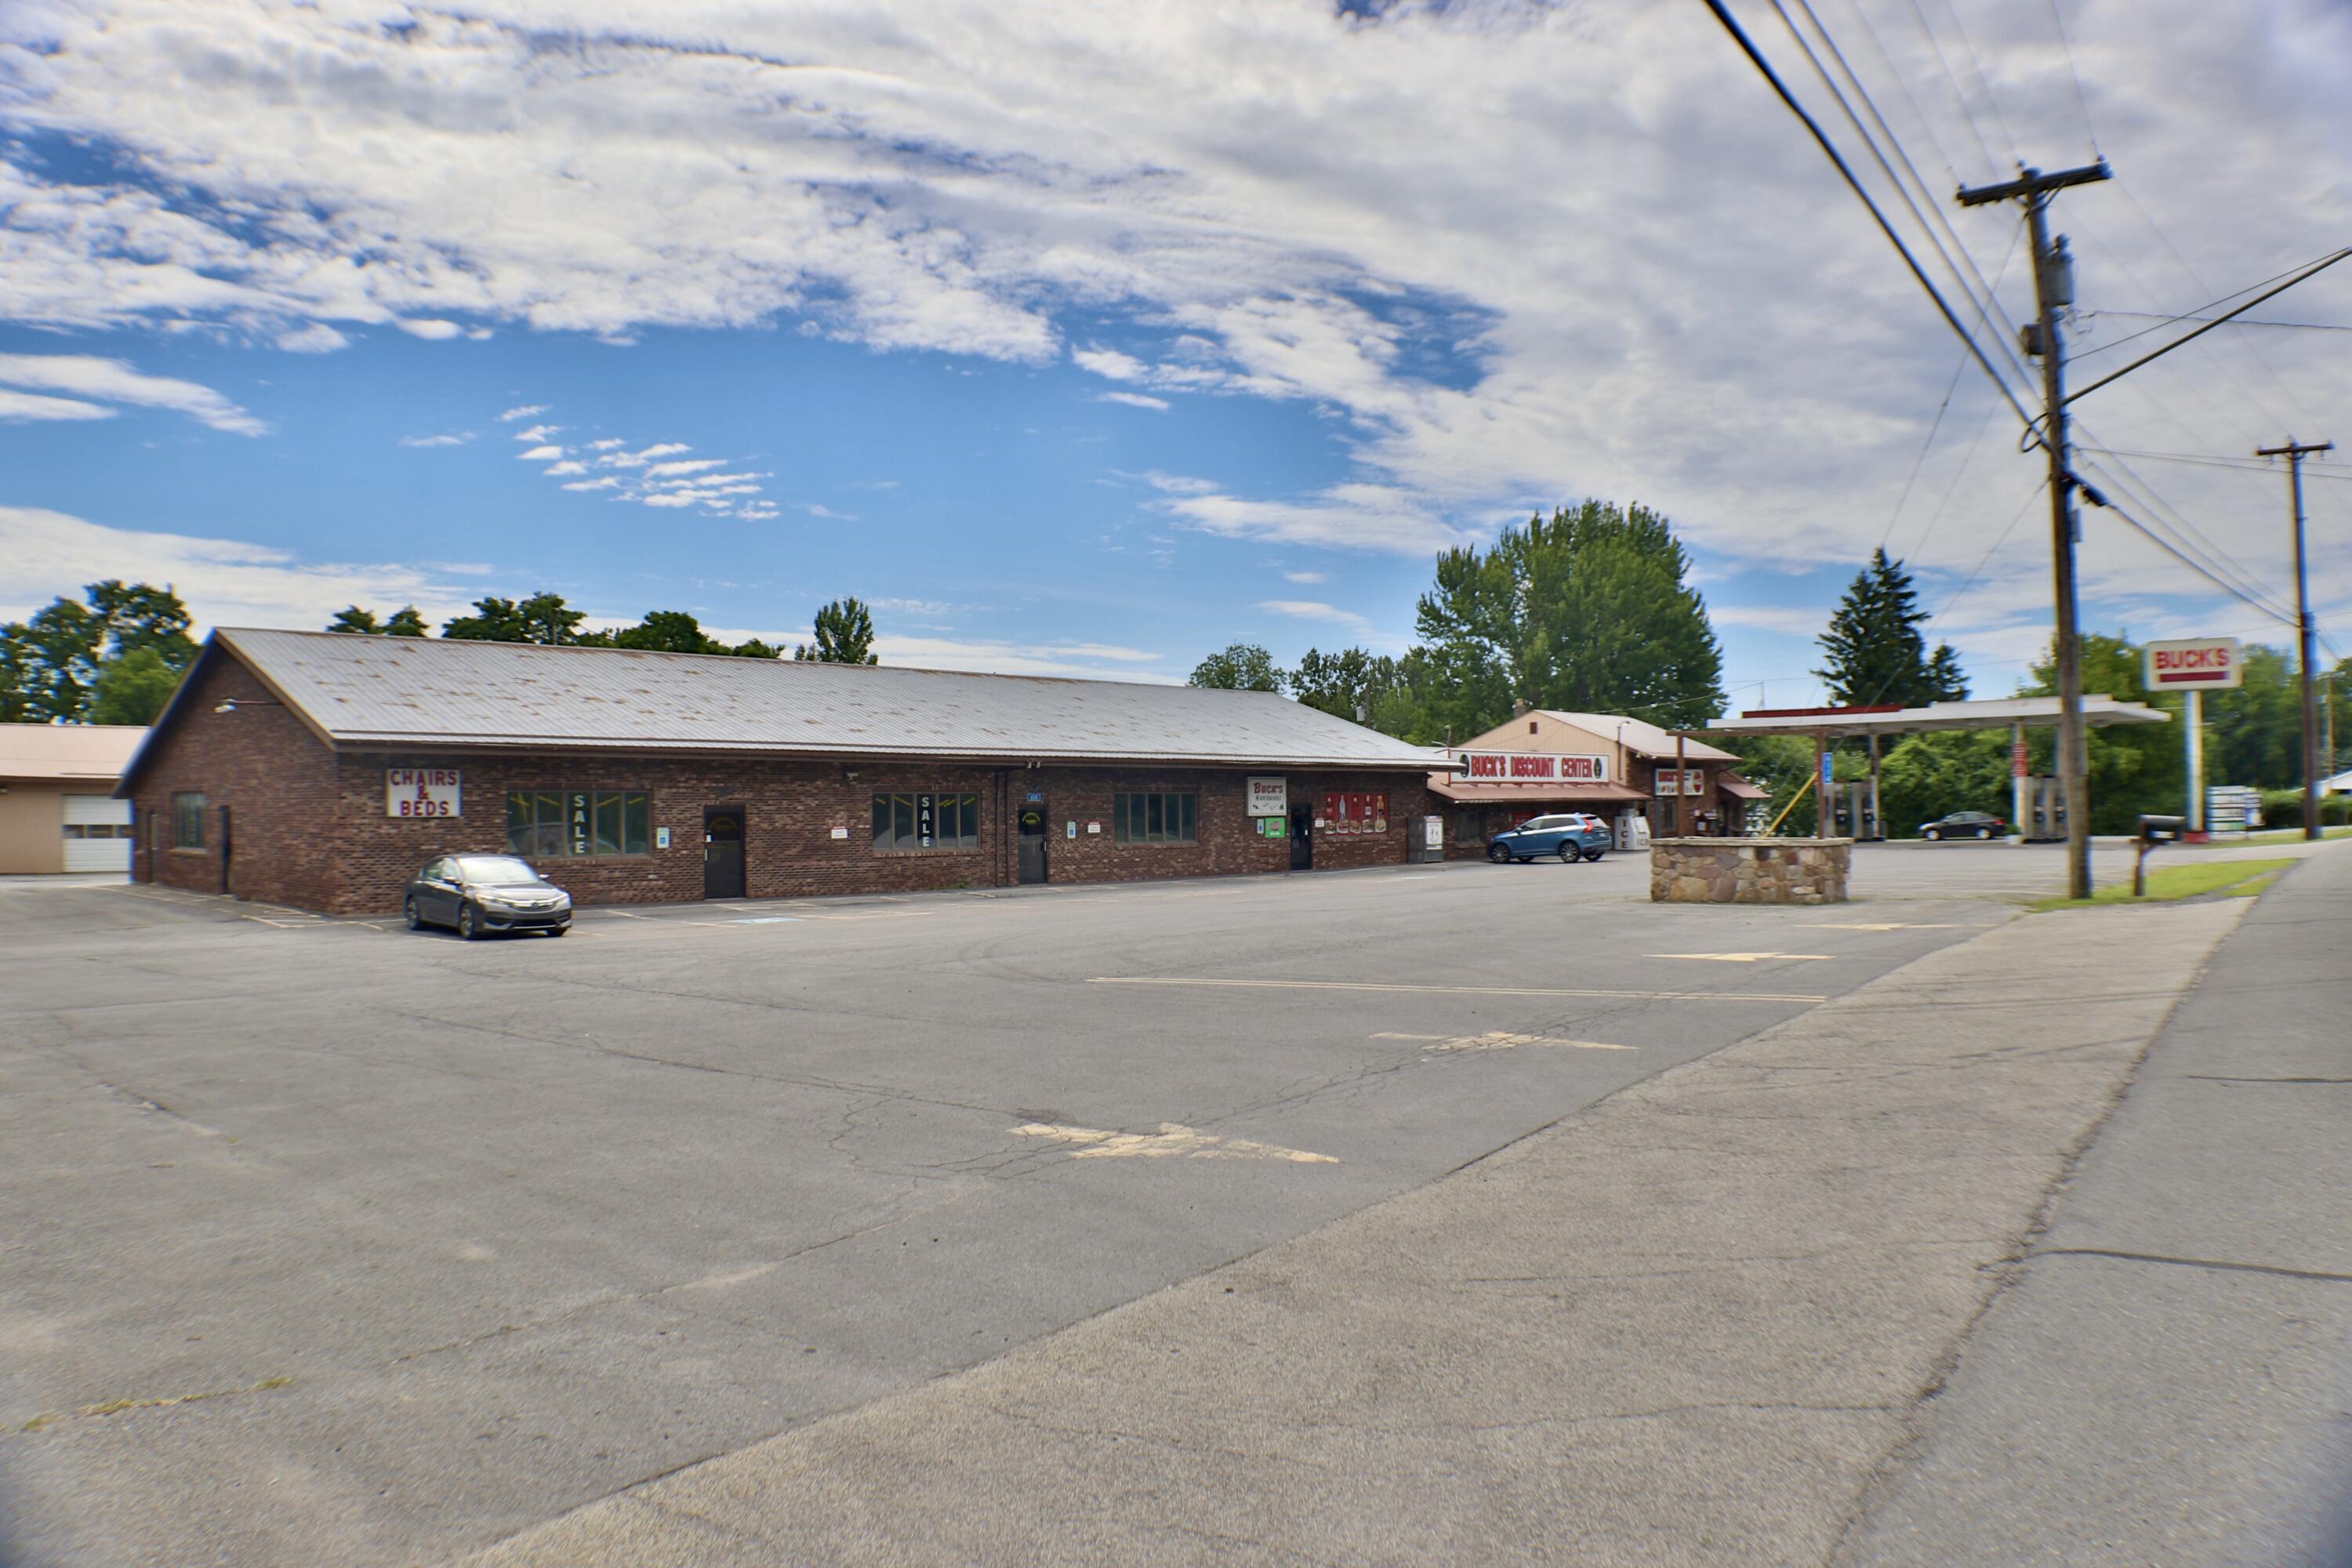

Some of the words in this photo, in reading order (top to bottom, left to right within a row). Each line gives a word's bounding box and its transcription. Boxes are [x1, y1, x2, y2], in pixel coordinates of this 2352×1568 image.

[2154, 648, 2230, 670] BUCK'S
[1471, 755, 1506, 777] BUCK'S
[1510, 757, 1555, 778] DISCOUNT
[1561, 757, 1593, 778] CENTER
[390, 770, 457, 786] CHAIRS
[1254, 782, 1284, 793] BUCK'S
[417, 785, 429, 800] &
[401, 800, 449, 816] BEDS
[574, 795, 586, 854] SALE
[921, 797, 931, 848] SALE
[1621, 819, 1629, 849] ICE
